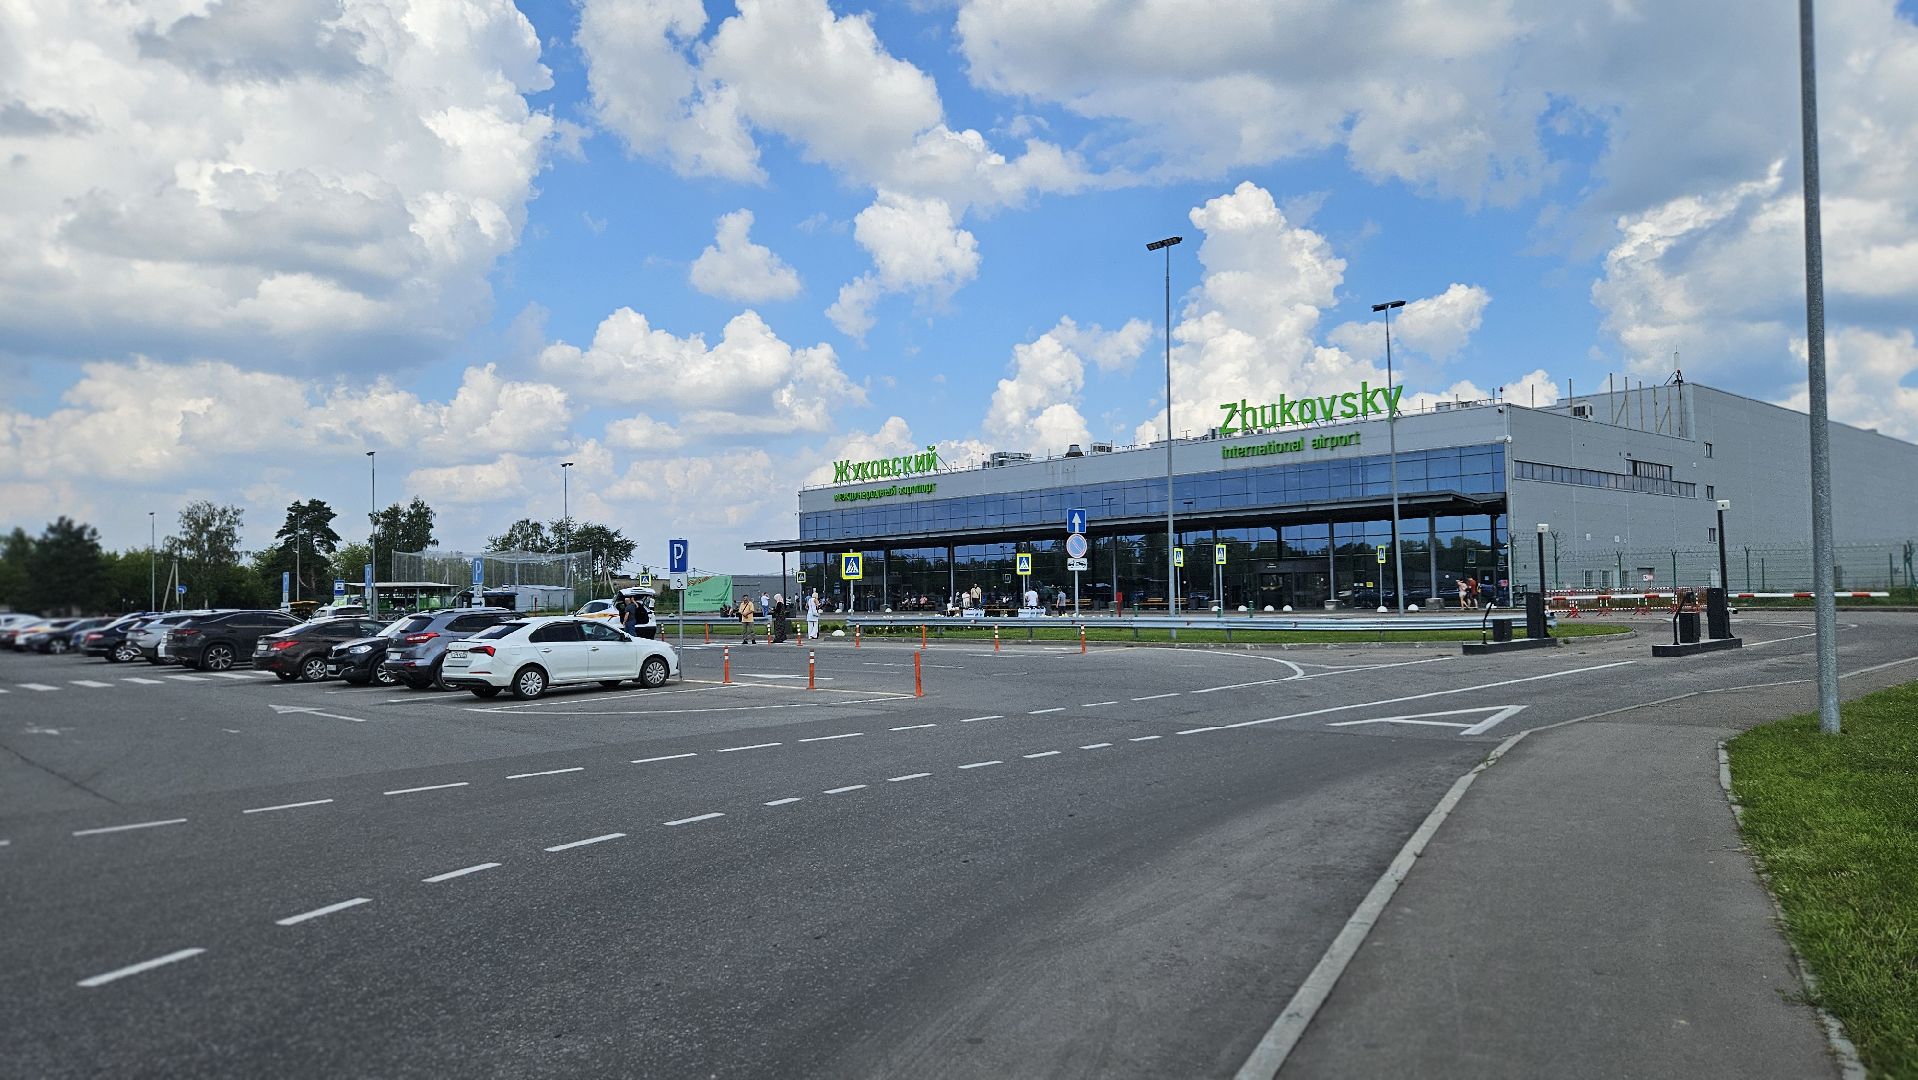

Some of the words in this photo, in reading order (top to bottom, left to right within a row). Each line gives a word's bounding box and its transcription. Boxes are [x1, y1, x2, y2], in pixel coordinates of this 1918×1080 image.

[1219, 381, 1403, 434] Zhukovsky
[1221, 437, 1305, 460] international
[1311, 431, 1361, 451] airport
[674, 544, 684, 569] P
[475, 560, 482, 581] P
